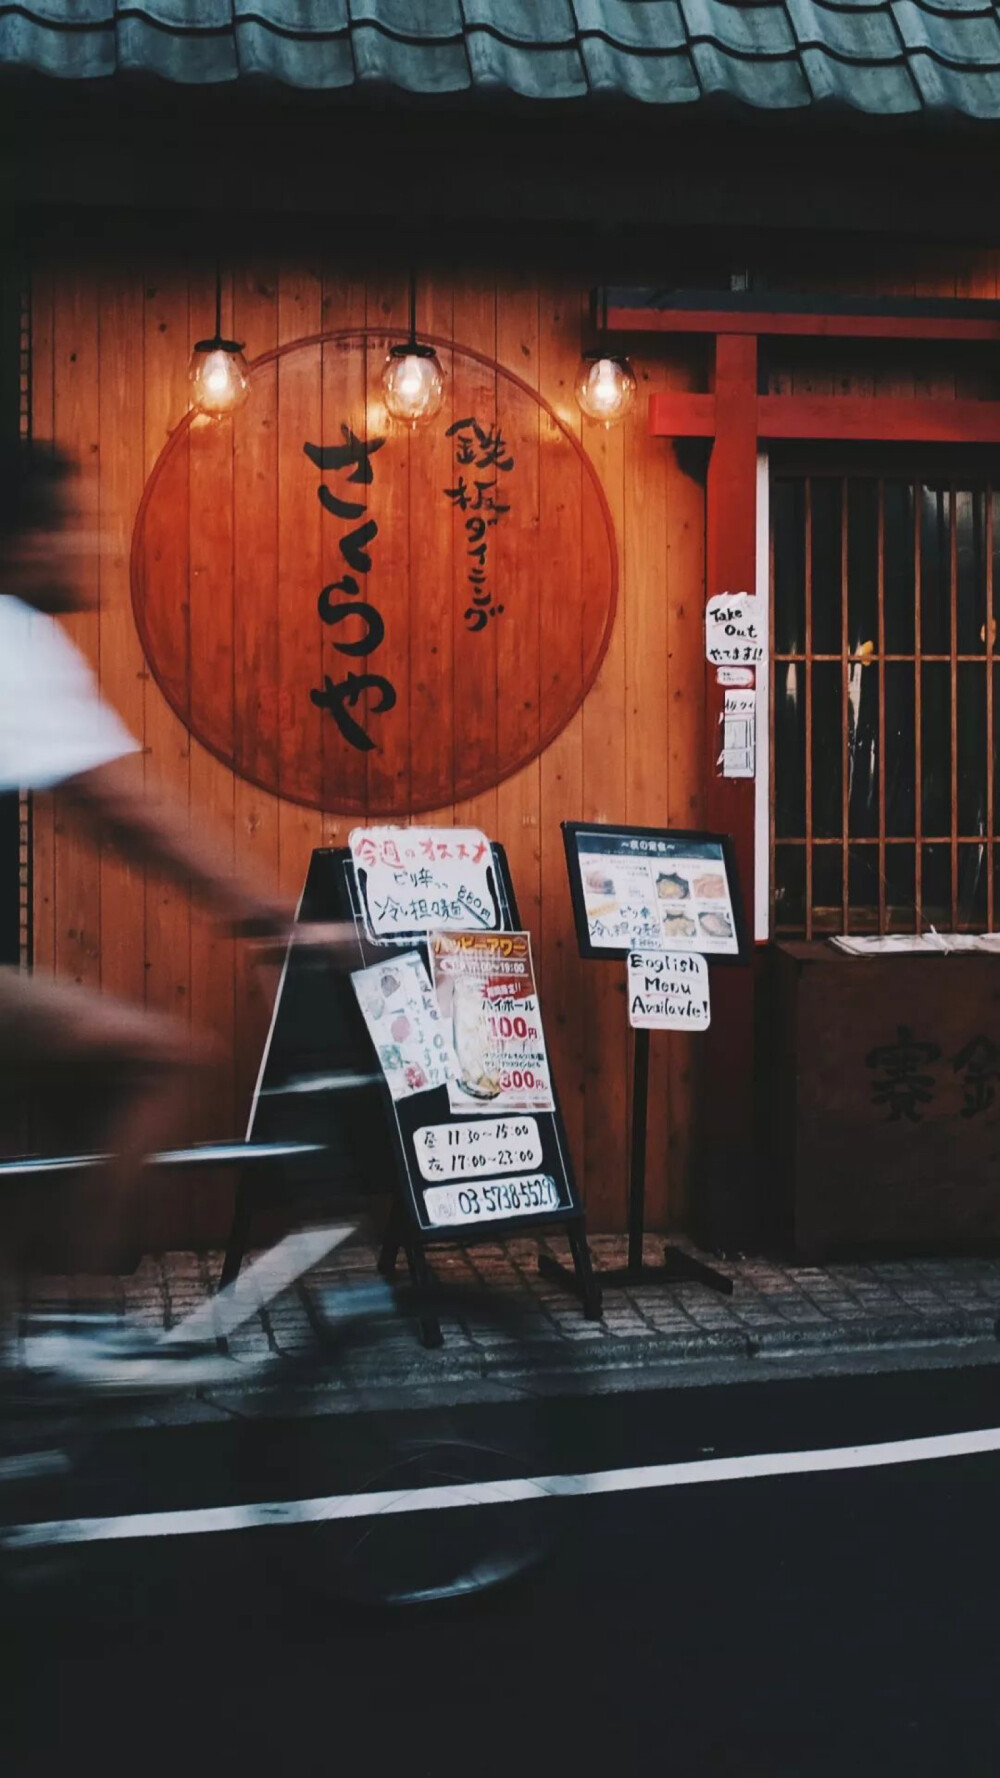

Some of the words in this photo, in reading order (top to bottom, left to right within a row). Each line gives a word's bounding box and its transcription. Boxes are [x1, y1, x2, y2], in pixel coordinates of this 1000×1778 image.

[444, 417, 514, 632] 鉄板ダイニング
[303, 424, 397, 752] さくらや
[709, 607, 743, 623] Take
[724, 624, 758, 638] Out
[434, 935, 526, 957] ハッピーアワー
[630, 954, 700, 974] English
[644, 977, 692, 995] Menu
[482, 1000, 535, 1012] ハイボール
[488, 1016, 538, 1040] 100円
[458, 1177, 555, 1215] 03-5738-5529
